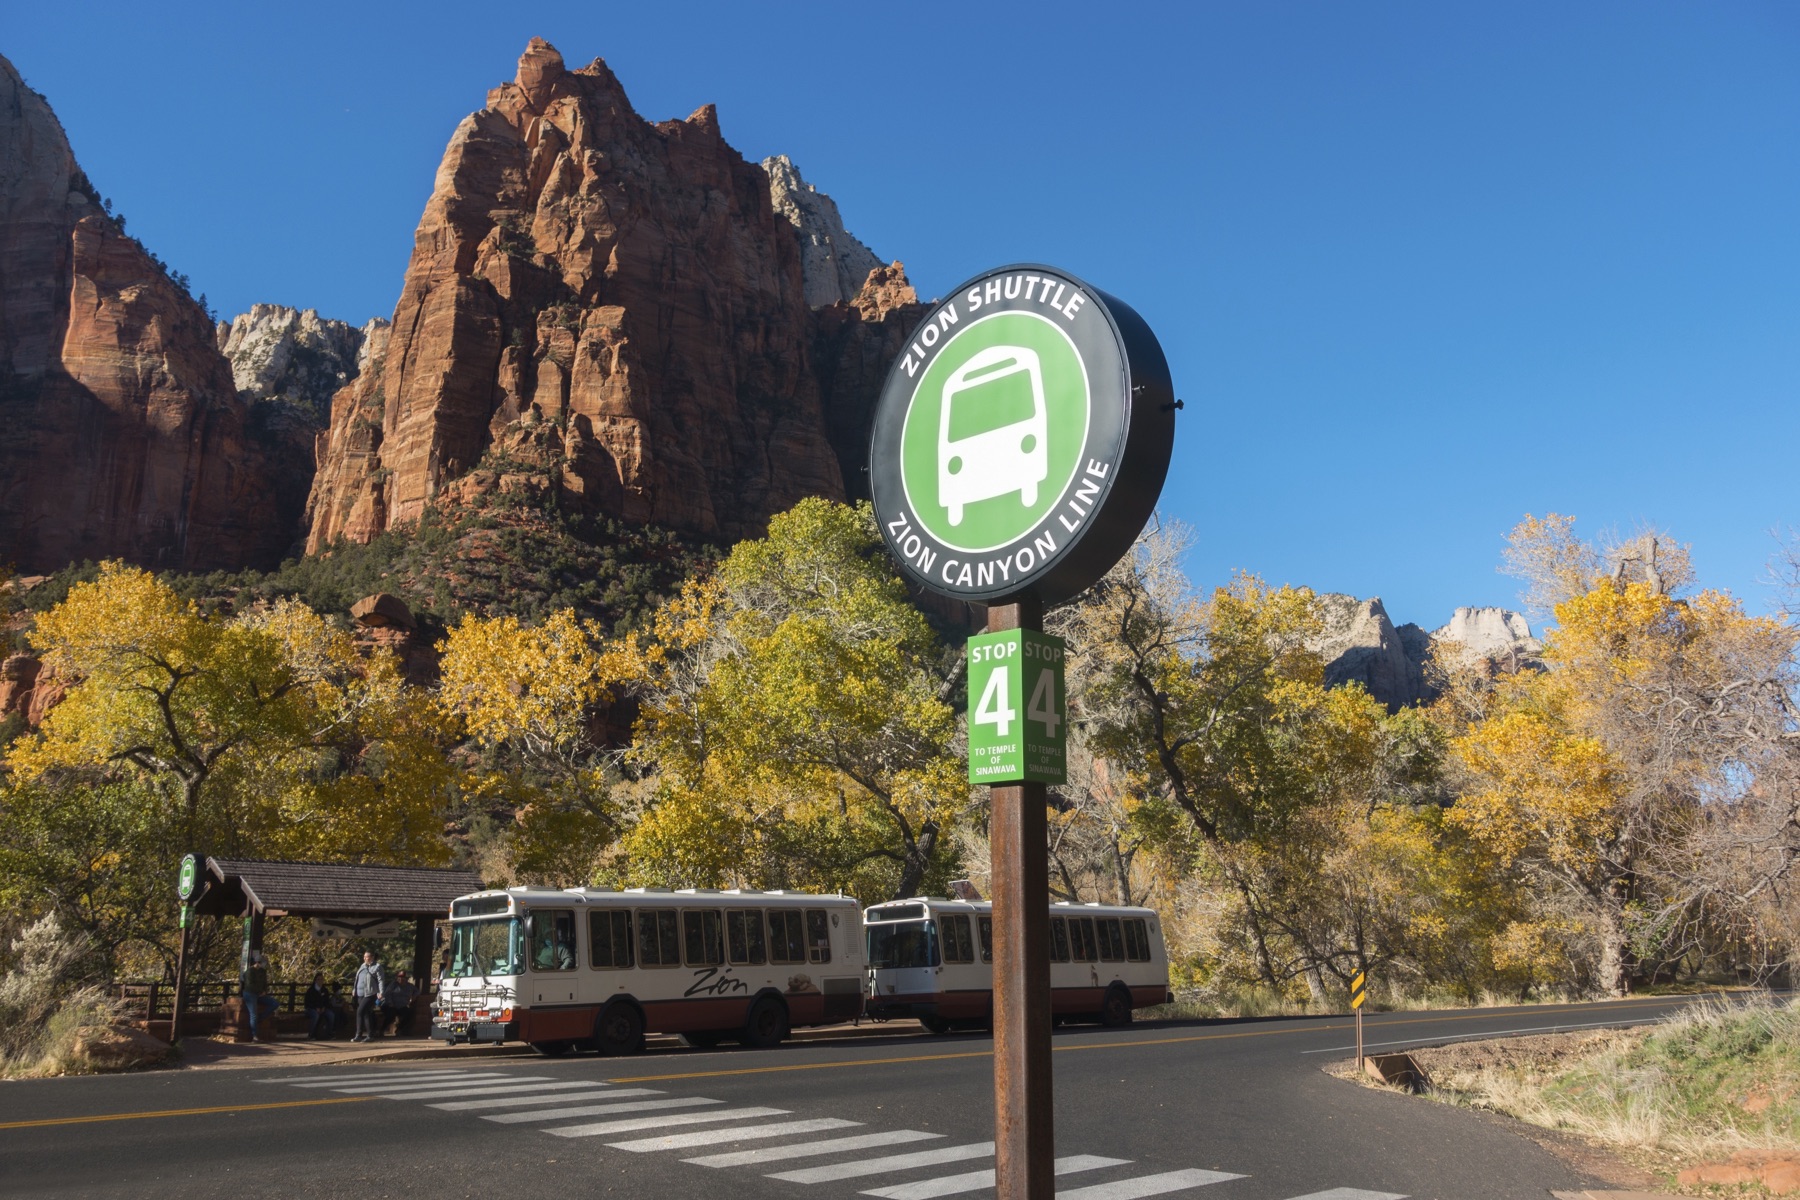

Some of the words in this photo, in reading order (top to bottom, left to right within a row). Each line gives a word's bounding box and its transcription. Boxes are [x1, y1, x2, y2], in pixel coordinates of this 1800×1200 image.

[900, 303, 959, 378] ZION
[967, 275, 1085, 321] SHUTTLE
[887, 512, 937, 574] ZION
[942, 532, 1058, 587] CANYON
[1058, 458, 1109, 534] LINE
[972, 641, 1017, 664] STOP
[1025, 641, 1062, 663] STOP
[974, 665, 1016, 737] 4
[1027, 667, 1061, 738] 4
[975, 747, 986, 757] TO
[987, 744, 1017, 756] TEMPLE
[990, 755, 1002, 765] OF
[1028, 743, 1037, 753] TO
[1038, 744, 1062, 757] TEMPLE
[1040, 755, 1050, 765] OF
[975, 763, 1017, 776] SINAWAVA
[1028, 763, 1062, 777] SINAWAVA
[684, 967, 748, 998] Zion
